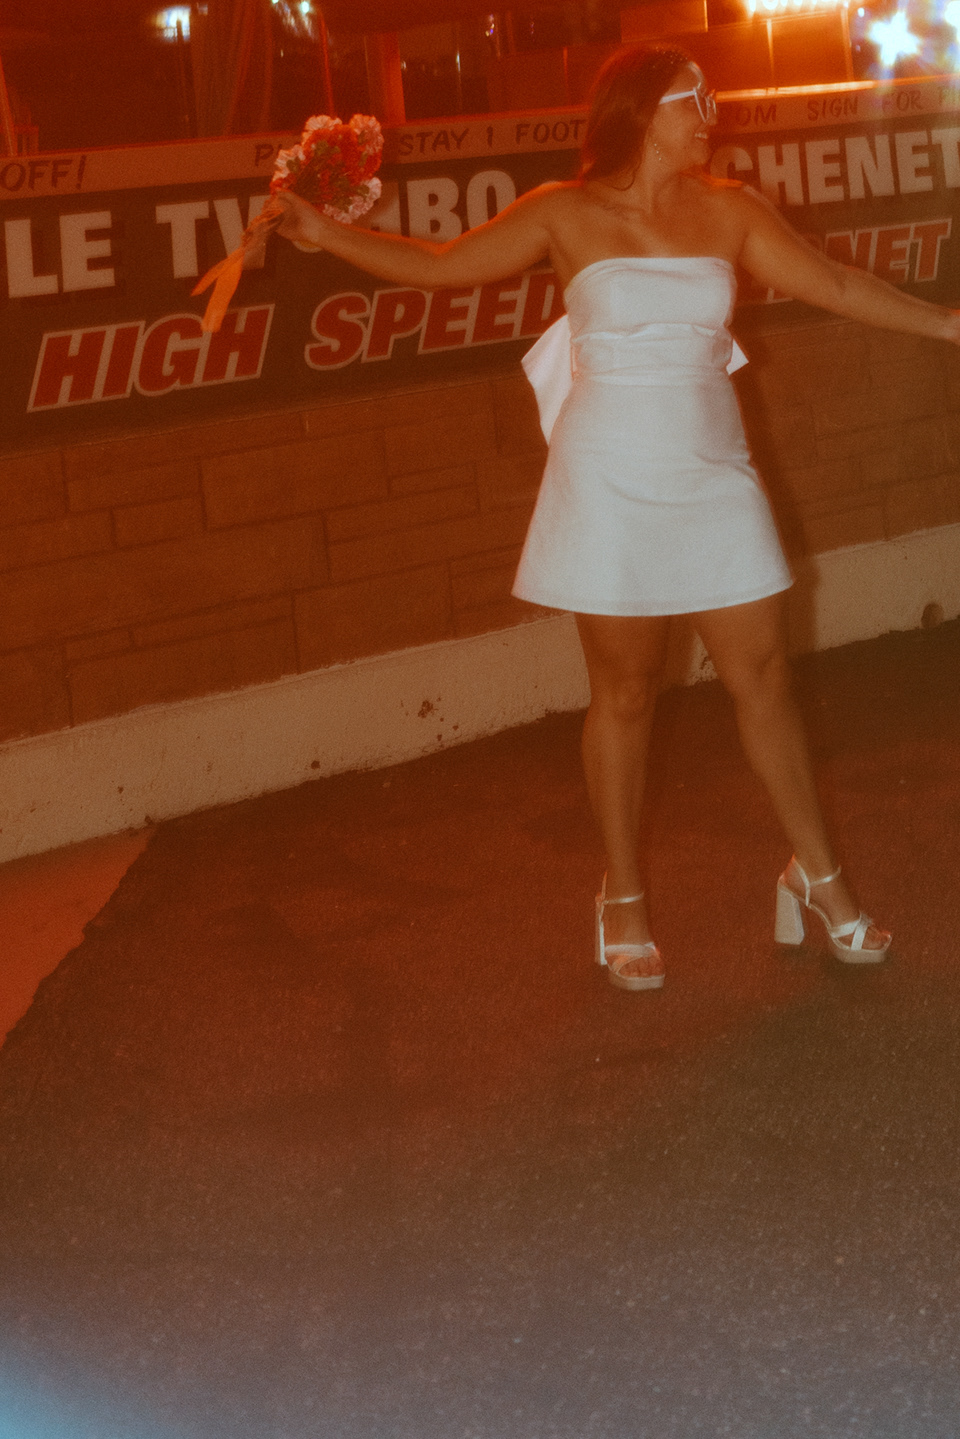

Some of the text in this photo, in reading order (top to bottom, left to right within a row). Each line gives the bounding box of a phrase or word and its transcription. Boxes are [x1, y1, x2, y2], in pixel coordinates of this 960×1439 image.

[397, 128, 470, 157] STAY
[514, 119, 587, 146] FOOT
[806, 94, 859, 123] SIGN
[881, 90, 923, 111] FOR
[1, 155, 88, 193] OFF!
[27, 303, 276, 413] HIGH
[304, 267, 566, 372] SPEED
